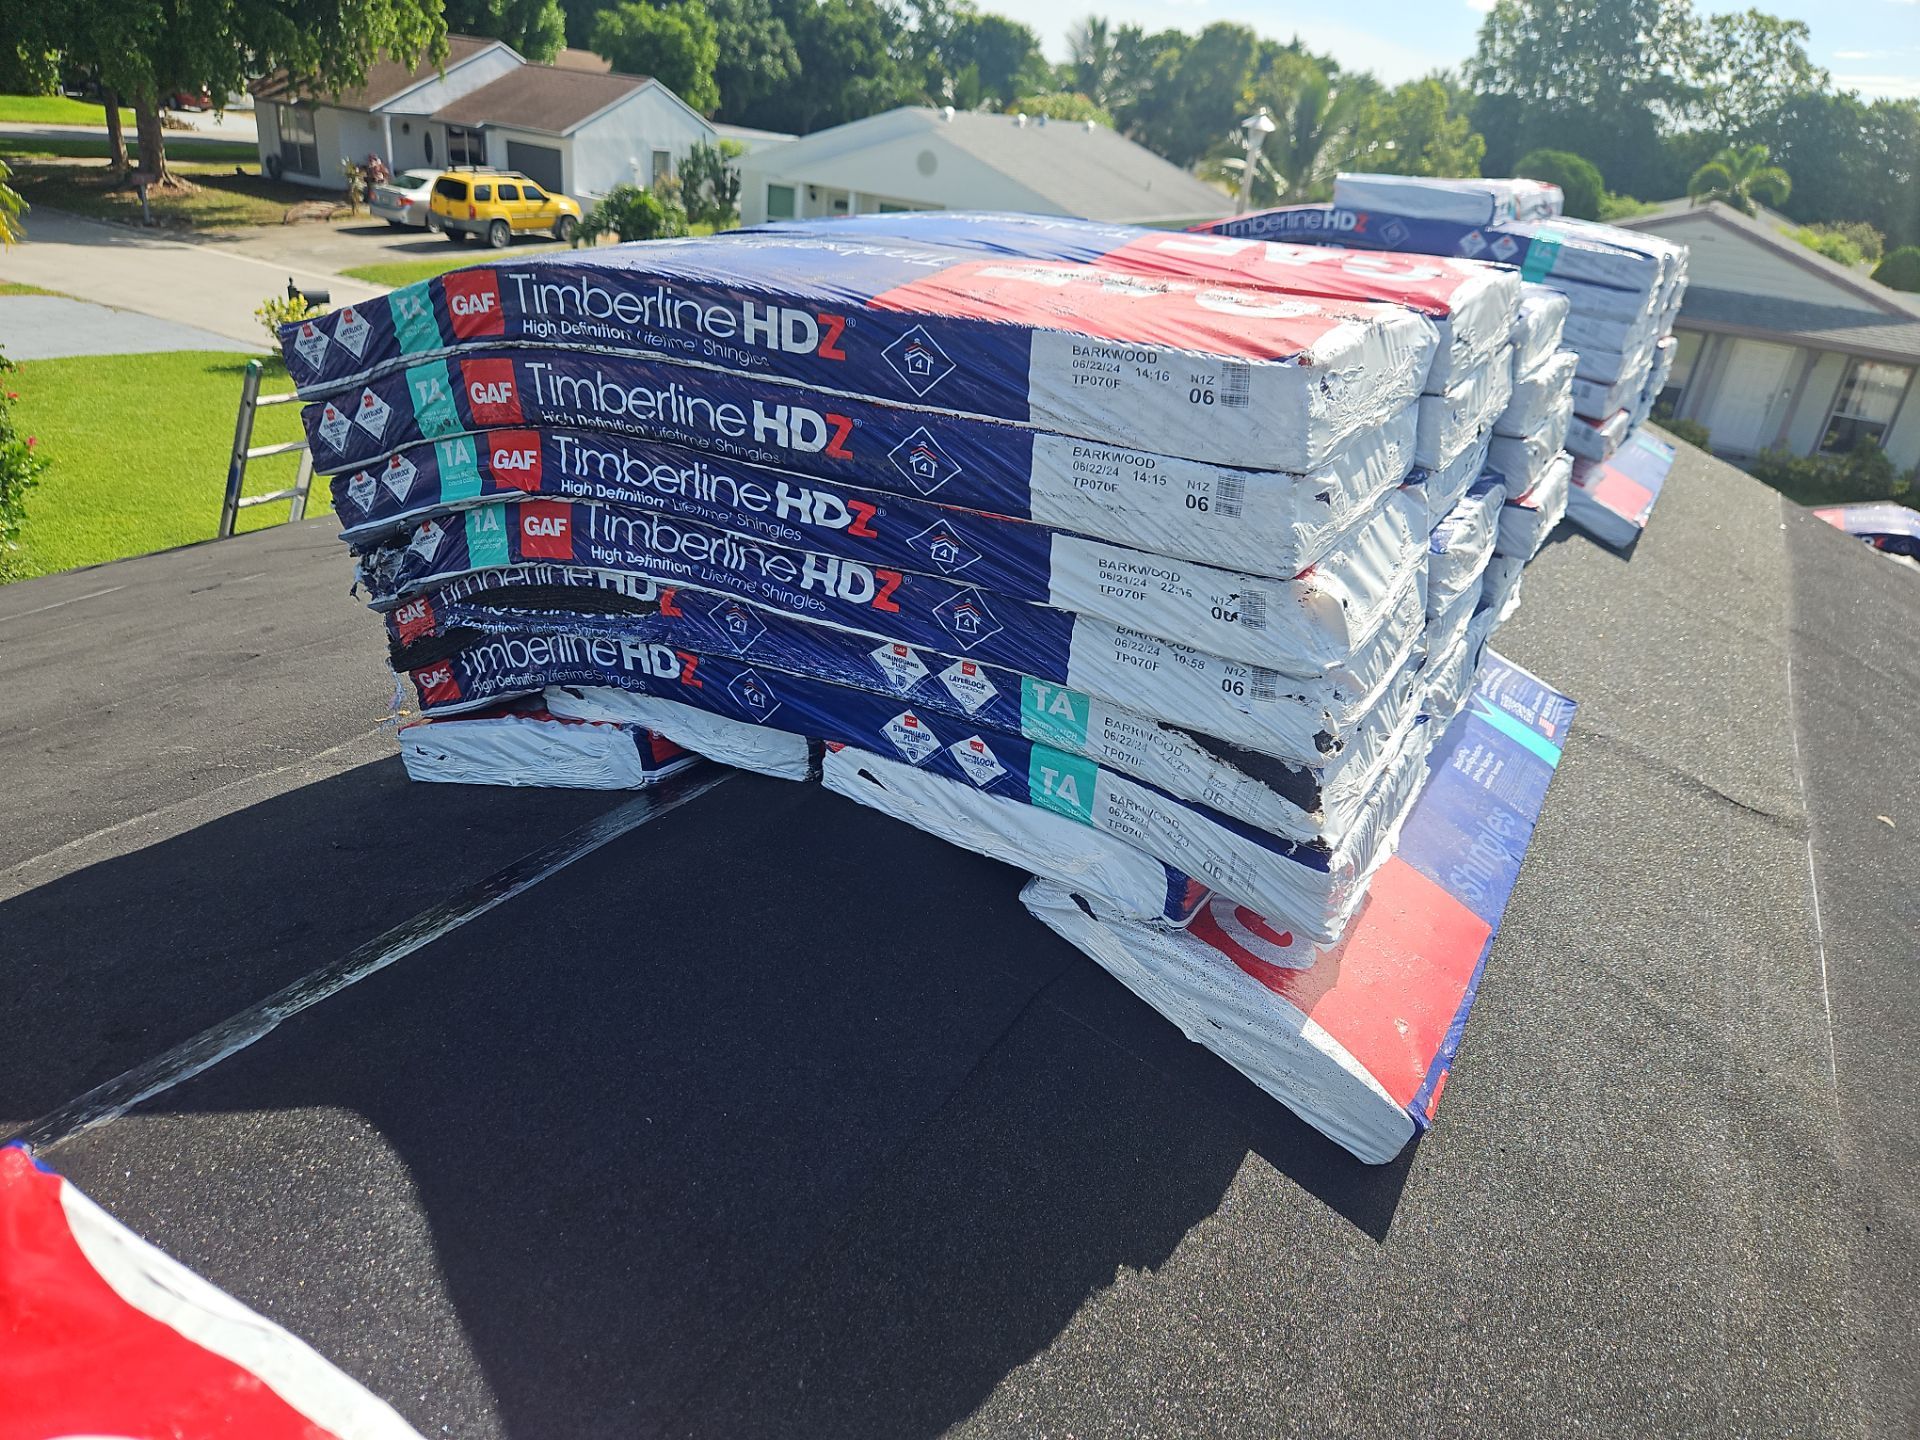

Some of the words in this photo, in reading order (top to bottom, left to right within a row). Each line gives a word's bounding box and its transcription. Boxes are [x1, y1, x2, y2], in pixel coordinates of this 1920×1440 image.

[396, 296, 428, 320] TA
[451, 291, 495, 316] GAF
[509, 273, 736, 338] Timberline
[523, 319, 556, 338] High
[561, 322, 629, 341] Definition
[703, 339, 770, 367] Shingles
[1072, 345, 1158, 365] BARKWOOD
[915, 358, 924, 370] 4
[1072, 359, 1121, 374] 06/22/24
[1135, 366, 1170, 382] 14:16
[415, 378, 447, 406] TA
[470, 381, 514, 405] GAF
[1072, 374, 1121, 389] TP070F
[524, 362, 748, 437] Timberline
[1188, 388, 1215, 405] 06
[542, 410, 574, 428] High
[578, 414, 645, 436] Definition
[715, 438, 781, 464] Shingles
[441, 440, 472, 467] TA
[493, 449, 537, 470] GAF
[1072, 446, 1156, 470] BARKWOOD
[552, 435, 771, 512] Timberline
[920, 461, 929, 473] 4
[1072, 460, 1120, 477] 06/22/24
[1132, 470, 1168, 486] 14:15
[1072, 476, 1120, 493] TP070F
[561, 479, 591, 497] High
[596, 483, 664, 508] Definition
[737, 513, 802, 541] Shingles
[1185, 494, 1209, 512] 06
[471, 508, 500, 533] TA
[523, 517, 567, 538] GAF
[590, 502, 798, 583] Timberline
[939, 548, 948, 560] 4
[591, 545, 622, 564] High
[625, 550, 692, 576] Definition
[761, 582, 827, 612] Shingles
[1098, 558, 1182, 583] BARKWOOD
[1099, 571, 1148, 588] 06/21/24
[1098, 584, 1149, 602] TP070F
[395, 599, 427, 625] GAF
[963, 617, 972, 629] 4
[733, 619, 742, 630] 4
[1114, 637, 1162, 657] 06/22/24
[1173, 652, 1207, 671] 10:58
[1114, 651, 1162, 672] TP070F
[418, 668, 451, 689] GAF
[472, 679, 496, 694] High
[498, 673, 546, 688] Definition
[1220, 677, 1245, 697] 06
[753, 692, 762, 703] 4
[1032, 683, 1076, 722] TA
[1104, 716, 1184, 757] BARKWOOD
[1040, 766, 1081, 806] TA
[1450, 806, 1521, 901] Shingles
